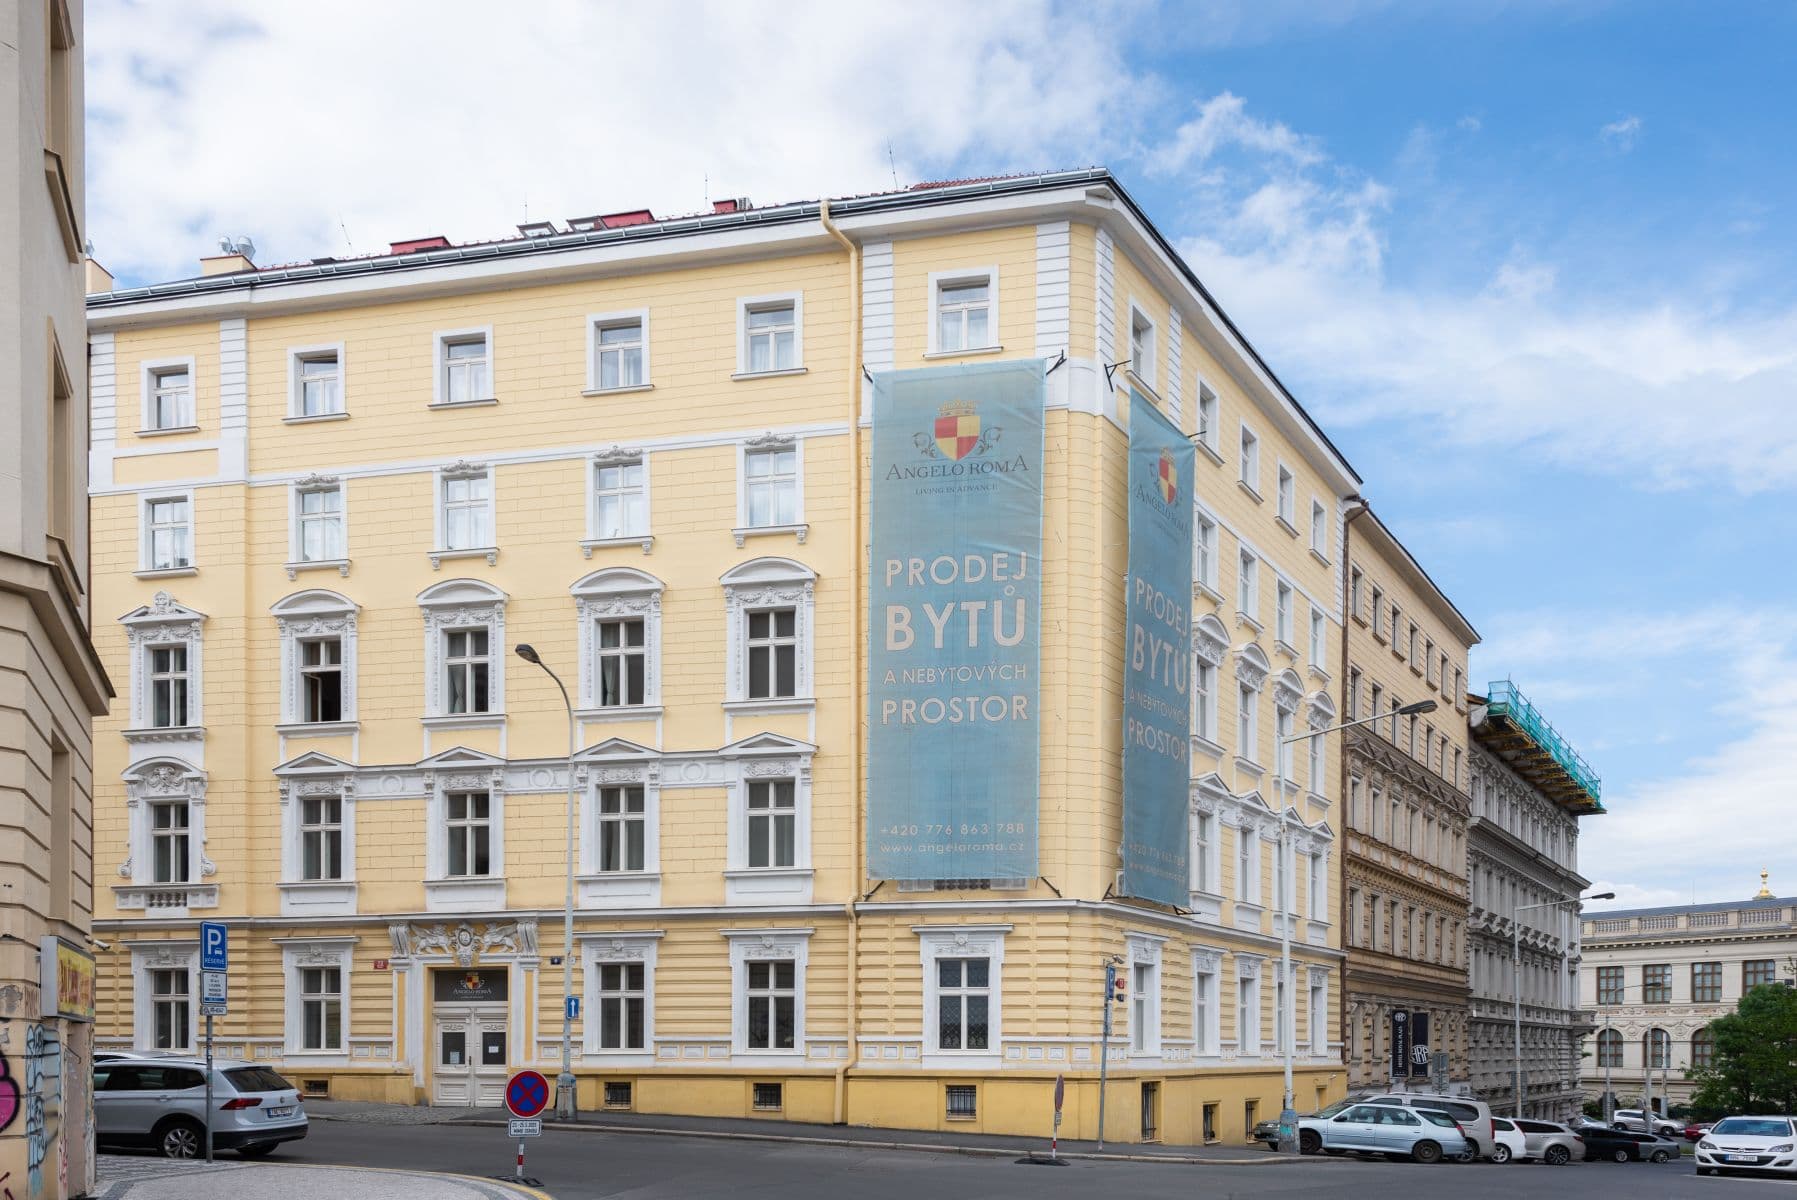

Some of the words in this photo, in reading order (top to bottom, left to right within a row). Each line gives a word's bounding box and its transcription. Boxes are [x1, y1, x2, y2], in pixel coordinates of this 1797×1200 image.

[885, 462, 965, 481] ANGELO
[969, 454, 1029, 475] ROMA
[915, 486, 945, 496] LIVING
[956, 483, 998, 493] ADVANCE
[885, 551, 1028, 587] PRODEJ
[885, 584, 1026, 651] BYTŮ
[1135, 576, 1188, 638] PRODEJ
[883, 669, 897, 685] A
[902, 658, 1027, 684] NEBYTOVÝCH
[1132, 624, 1187, 694] BYTŮ
[1129, 688, 1136, 703] A
[881, 695, 1029, 725] PROSTOR
[1128, 716, 1187, 765] PROSTOR
[880, 824, 919, 836] +420
[926, 824, 953, 835] 776
[960, 823, 990, 835] 863
[997, 823, 1025, 834] 788
[207, 928, 222, 955] P
